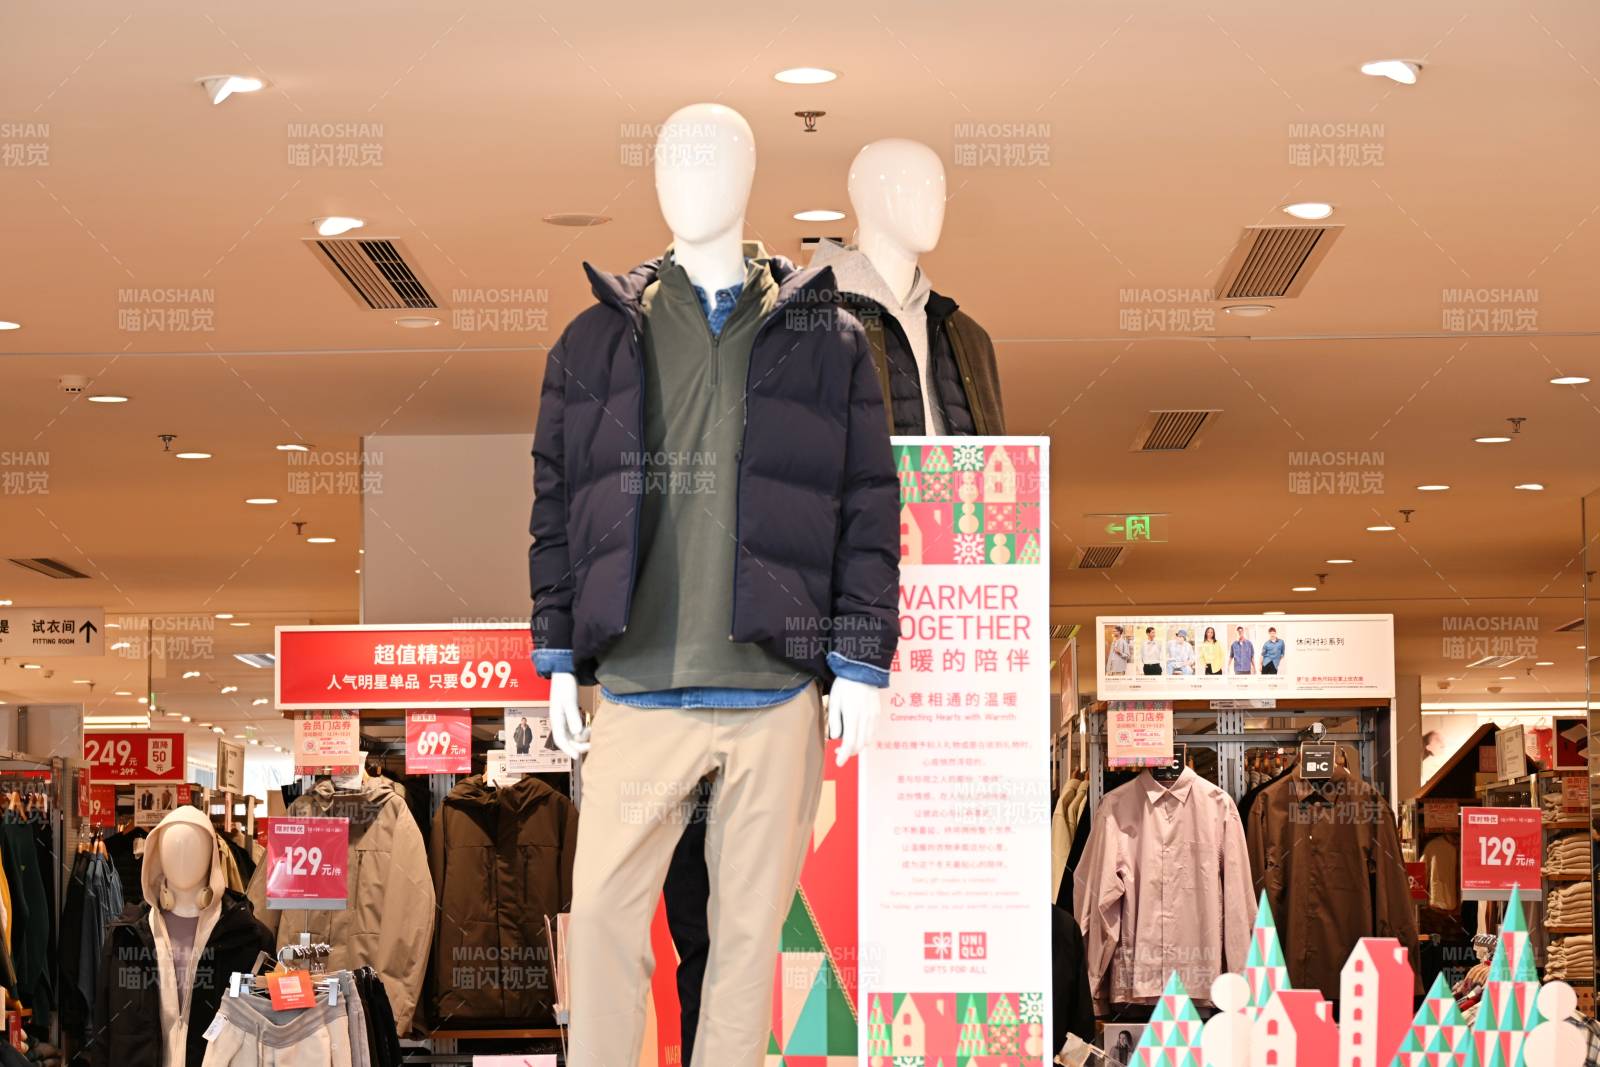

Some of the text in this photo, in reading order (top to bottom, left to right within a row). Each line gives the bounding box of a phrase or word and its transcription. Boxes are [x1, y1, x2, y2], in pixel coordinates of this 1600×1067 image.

[898, 585, 1018, 610] WARMER
[32, 619, 75, 634] 试衣间
[898, 615, 1030, 640] OGETHER
[1296, 637, 1345, 647] 休闲衬衫系列
[374, 644, 460, 665] 超值精选
[327, 674, 420, 690] 人气明星单品
[890, 692, 1017, 707] 心意相通的温暖
[303, 721, 352, 731] 会员门店券
[152, 751, 167, 762] 50
[156, 764, 164, 772] 元
[961, 935, 983, 945] UNI
[961, 946, 985, 958] QLO
[924, 965, 988, 974] GIFTS FOR ALL
